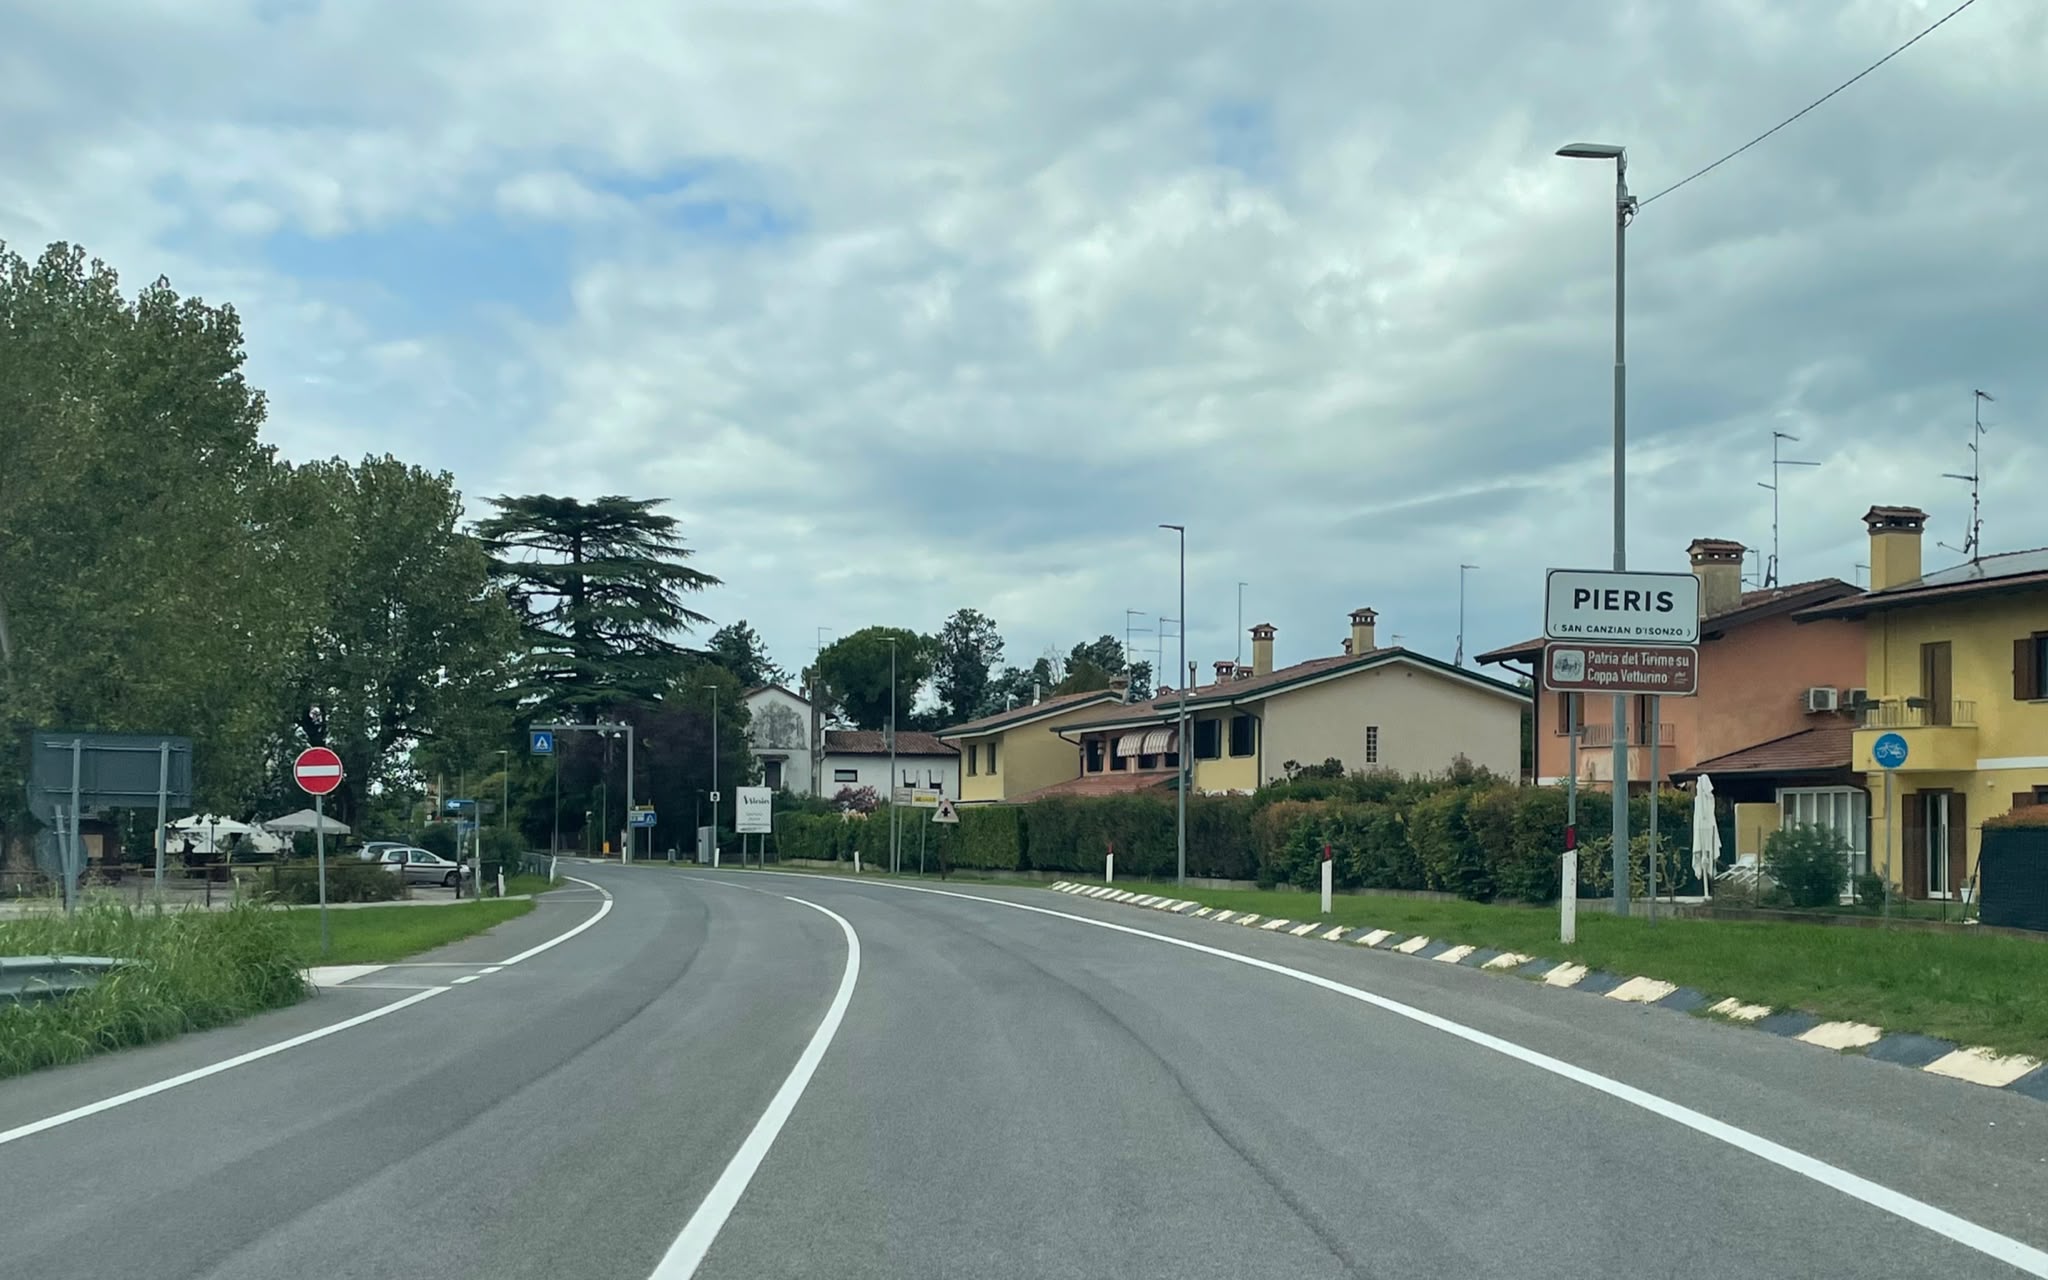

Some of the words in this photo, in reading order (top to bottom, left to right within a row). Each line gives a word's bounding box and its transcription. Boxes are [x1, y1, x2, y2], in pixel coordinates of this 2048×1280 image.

[1573, 588, 1674, 613] PIERIS
[1561, 624, 1582, 633] SAN
[1586, 625, 1631, 634] CANZIAN
[1635, 626, 1683, 636] D'ISONZO
[1588, 650, 1619, 665] Patria
[1621, 651, 1639, 666] del
[1587, 668, 1619, 685] Coppa
[1620, 668, 1668, 684] Vetturino
